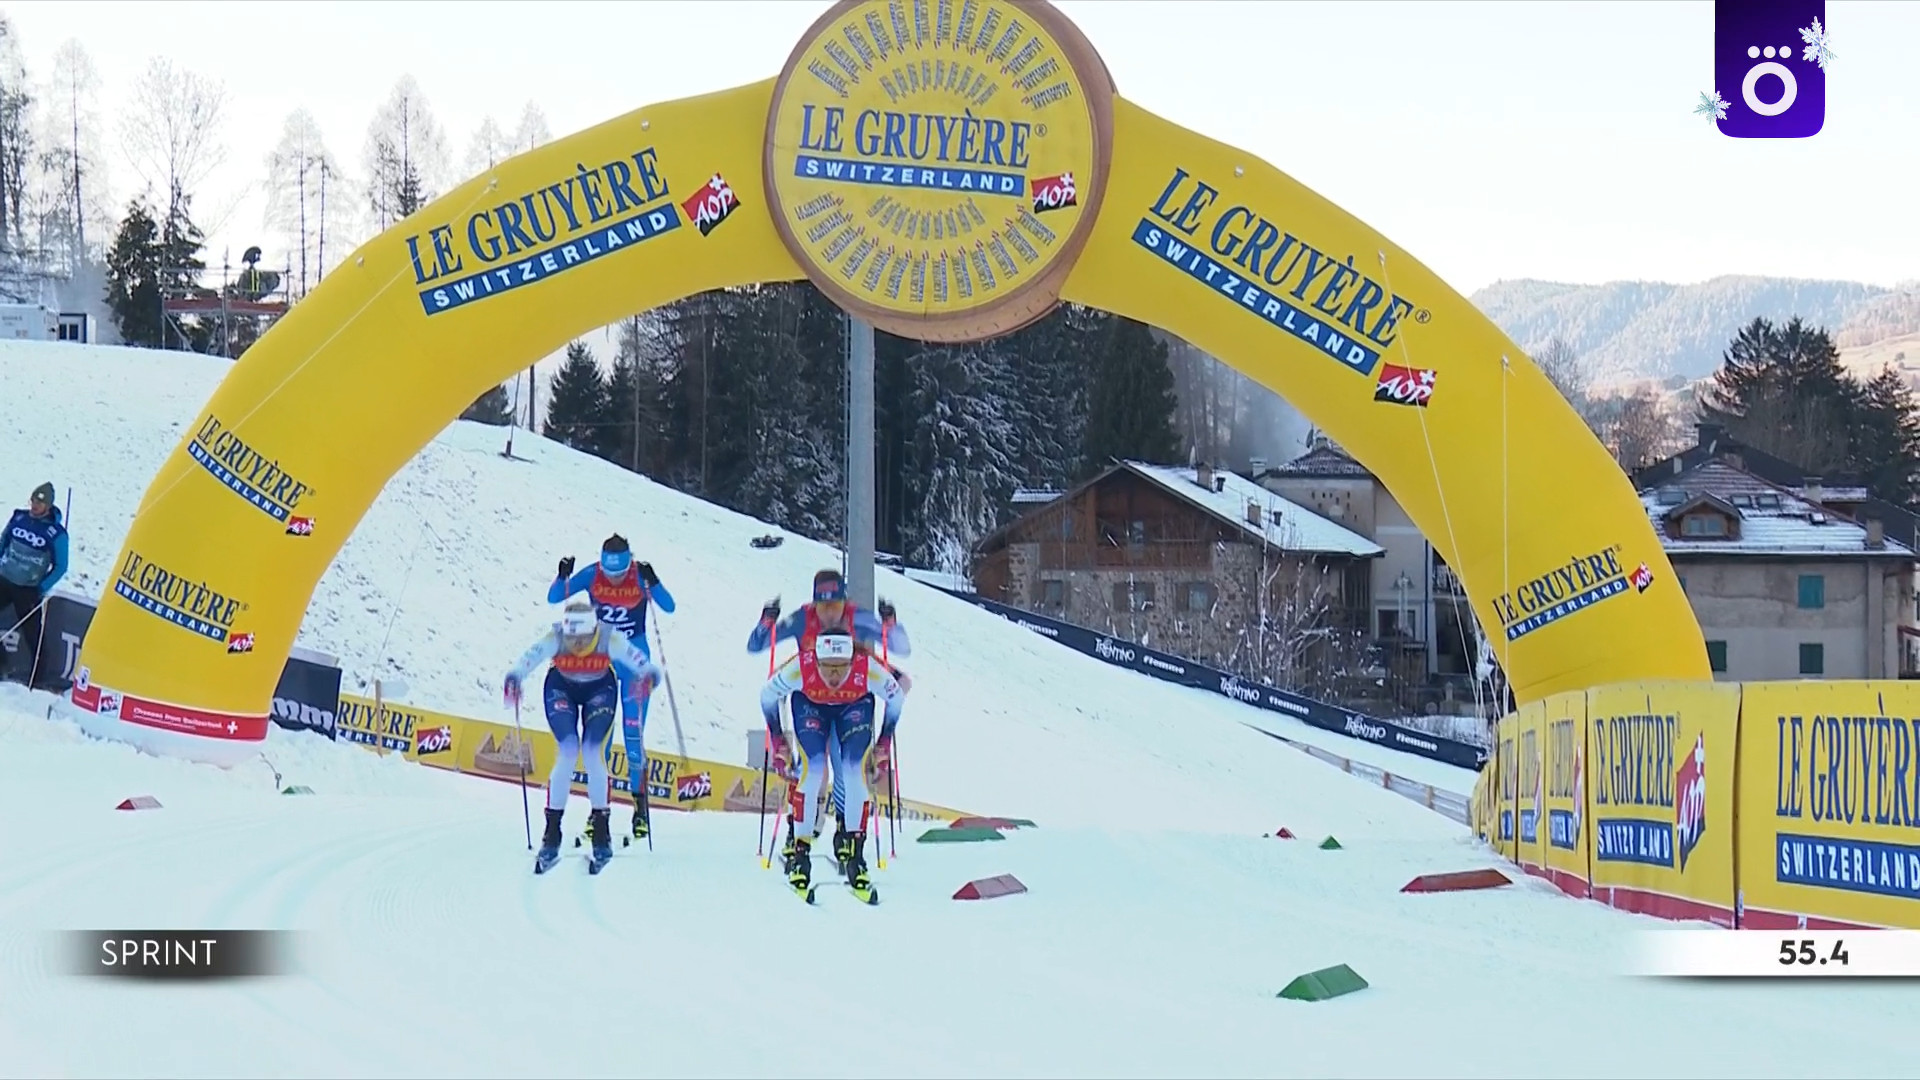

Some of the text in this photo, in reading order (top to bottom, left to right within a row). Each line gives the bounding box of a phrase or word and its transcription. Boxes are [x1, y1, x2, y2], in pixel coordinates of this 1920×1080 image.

[799, 104, 844, 152] LE
[855, 107, 1031, 169] GRUYÈRE
[806, 159, 1015, 192] SWITZERLAND
[1033, 182, 1076, 208] AOP
[405, 147, 669, 284] LE GRUYÈRE
[692, 187, 735, 229] AOP
[433, 213, 667, 308] SWITZERLAND
[1149, 167, 1219, 236] LE
[1210, 206, 1414, 348] GRUYÈRE
[1144, 228, 1366, 365] SWITZERLAND
[1375, 374, 1433, 404] AOP
[189, 443, 284, 518] SWITZERLAND
[197, 414, 308, 509] LE GRUYÈRE
[12, 527, 46, 547] coop
[116, 582, 222, 638] SWITZERLAND
[121, 550, 240, 627] LE GRUYÈRE
[1492, 547, 1623, 626] LE GRUYÈRE
[1509, 581, 1623, 638] SWITZERLAND
[601, 605, 629, 622] 22
[337, 700, 416, 738] RUYÈRE
[1220, 676, 1310, 715] TRENTINO fiemme
[418, 735, 450, 751] AOP
[1345, 714, 1438, 751] TRENTINO fiemme
[679, 782, 711, 797] AOP
[1776, 716, 1803, 818] LE
[1781, 840, 1920, 890] SWITZERLAND
